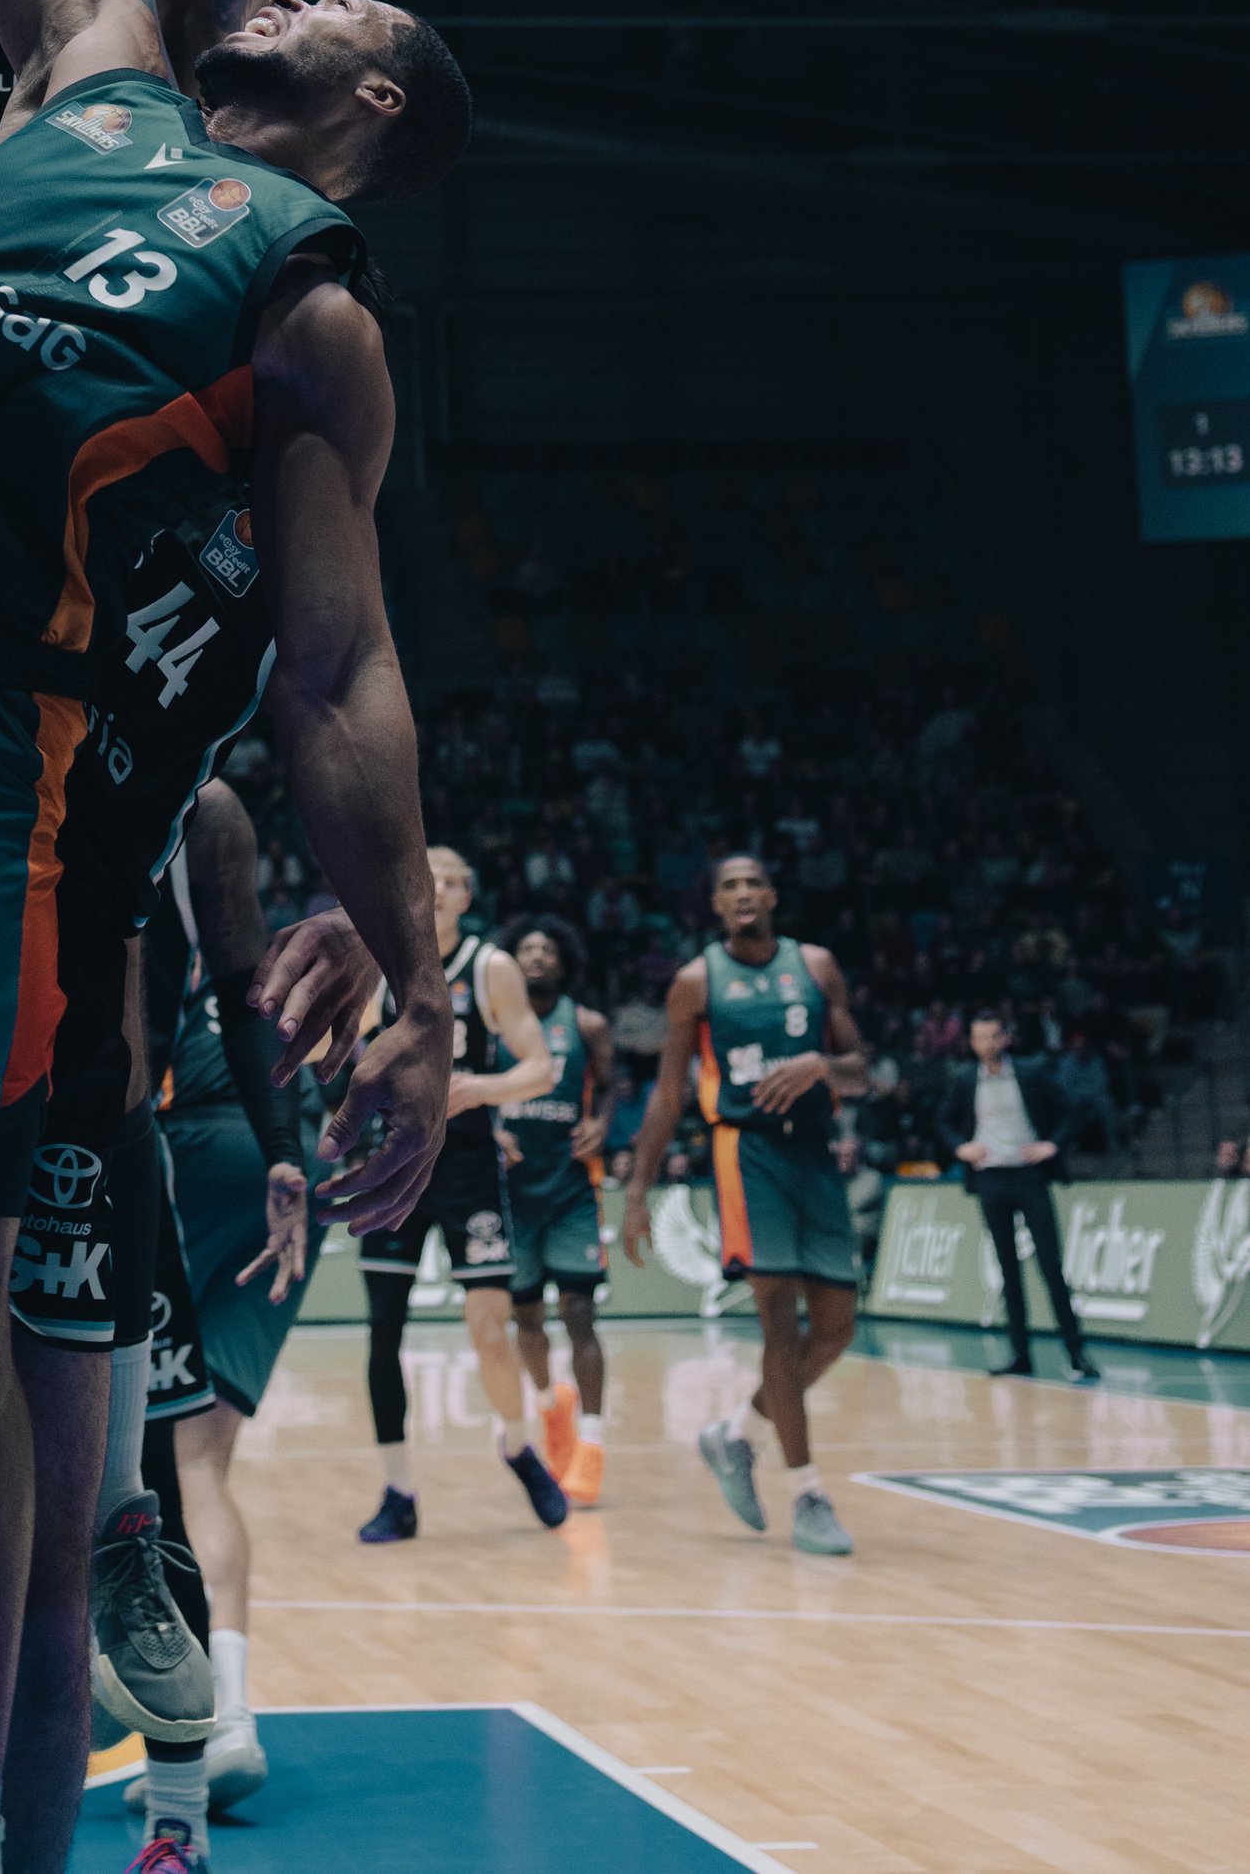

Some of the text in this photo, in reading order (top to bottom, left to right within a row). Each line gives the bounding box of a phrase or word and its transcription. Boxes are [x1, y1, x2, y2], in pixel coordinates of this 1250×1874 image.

[166, 207, 208, 241] BBL
[63, 228, 179, 309] 13
[205, 547, 241, 588] BBL
[125, 580, 222, 710] 44
[20, 1215, 93, 1237] tohaus
[9, 1234, 110, 1300] S+K
